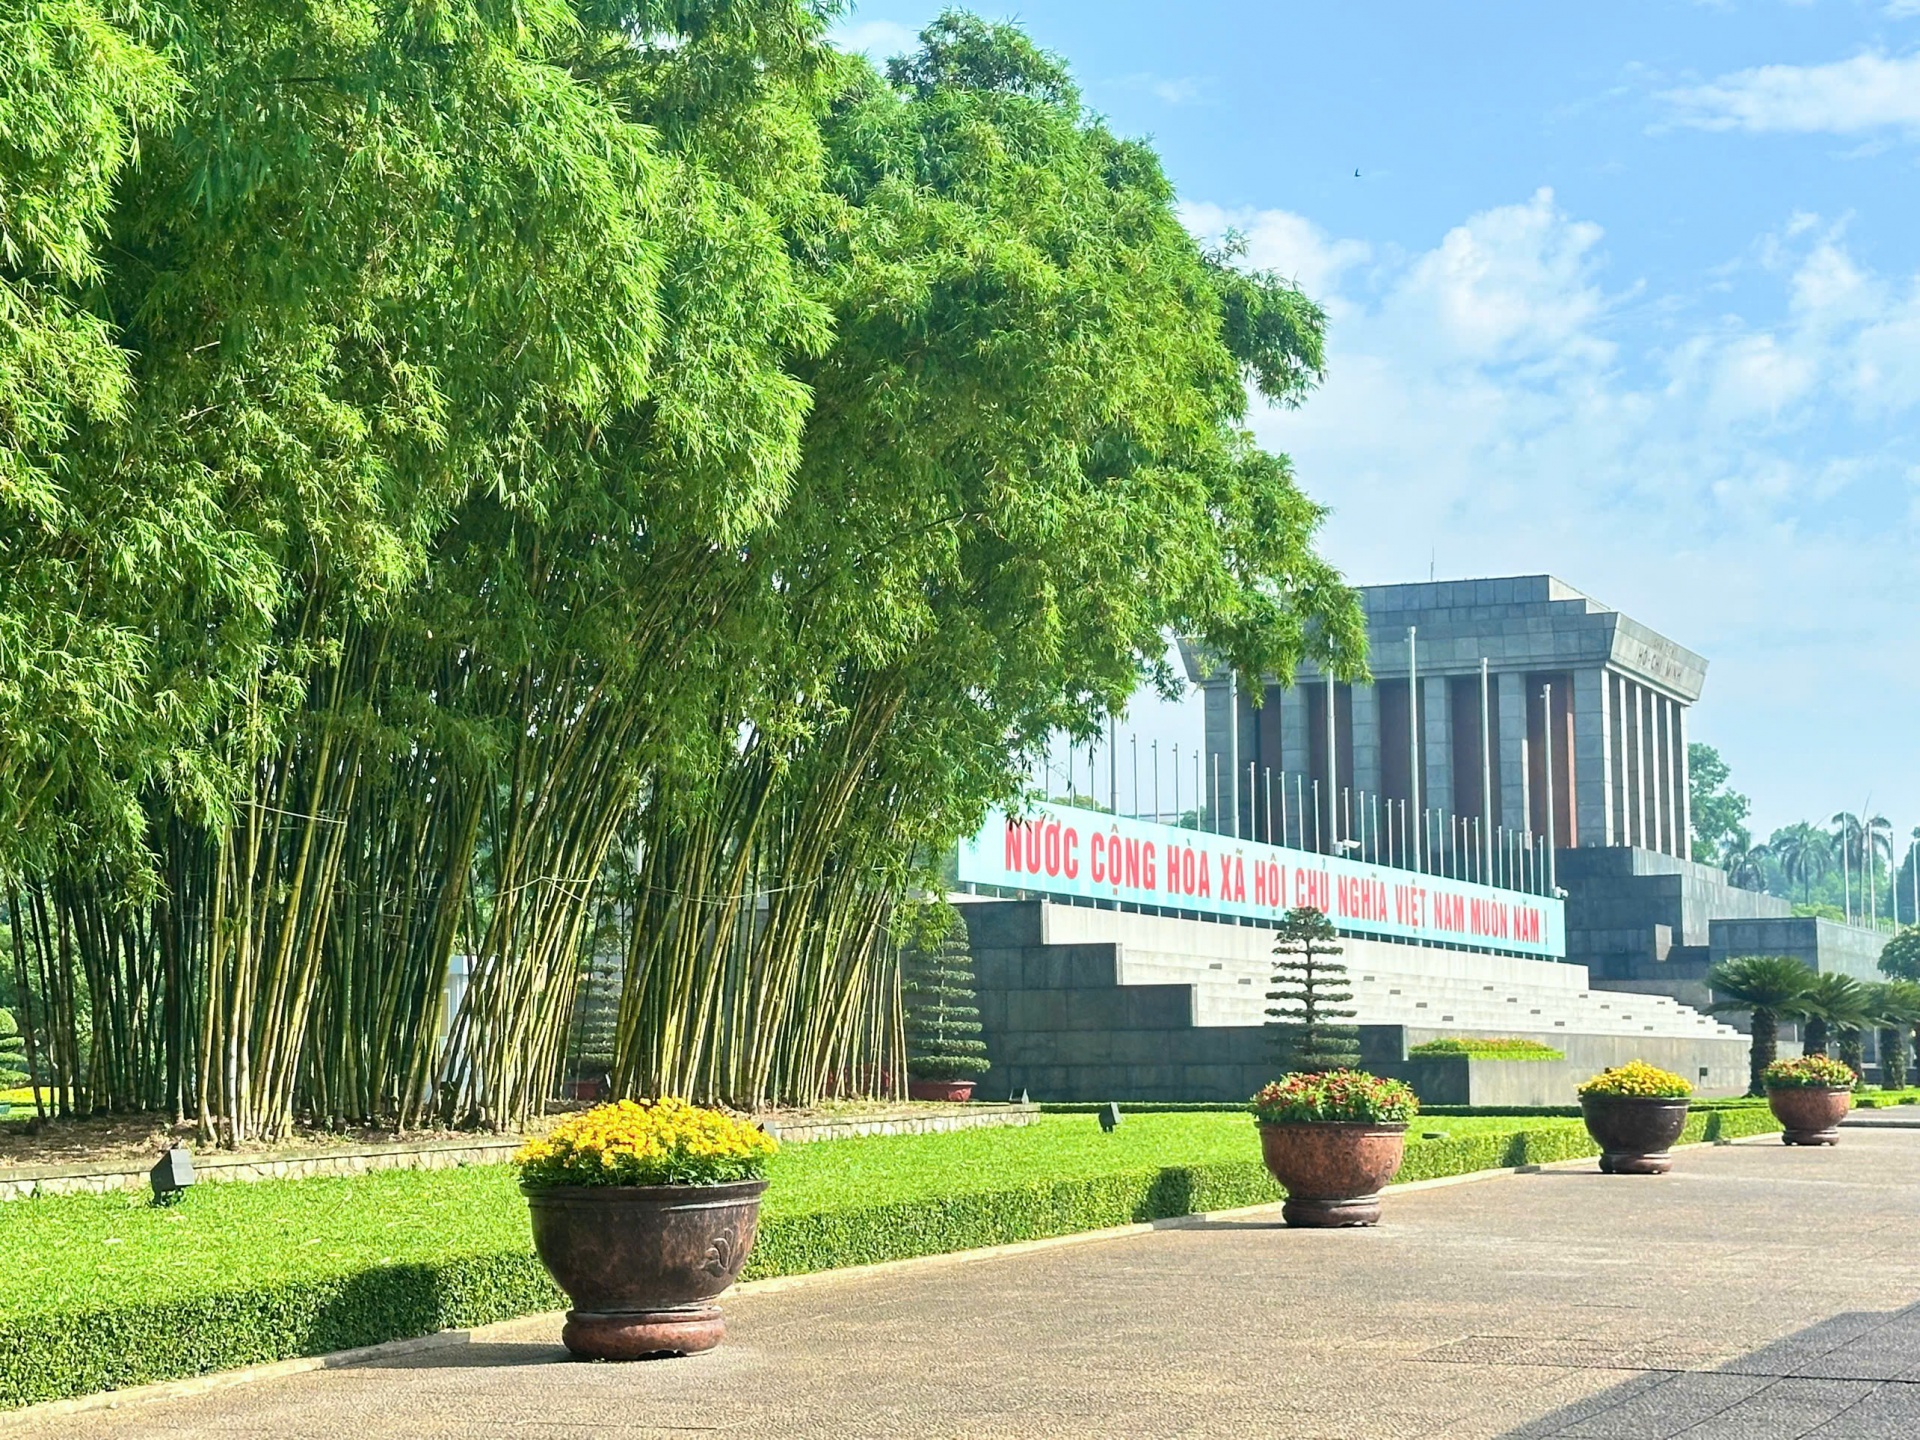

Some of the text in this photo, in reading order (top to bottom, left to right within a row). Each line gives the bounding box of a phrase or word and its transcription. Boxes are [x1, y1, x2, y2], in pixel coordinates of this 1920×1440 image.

[1091, 823, 1156, 895] CỘNG
[1167, 838, 1210, 898] HÒA
[1220, 848, 1246, 903] XÃ
[1255, 853, 1286, 917] HỘI
[1295, 857, 1329, 914] CHỦ
[1338, 873, 1387, 923] NGHĨA
[1395, 878, 1426, 934] VIỆT
[1434, 891, 1465, 933] NAM
[1470, 893, 1507, 939] MUÔN
